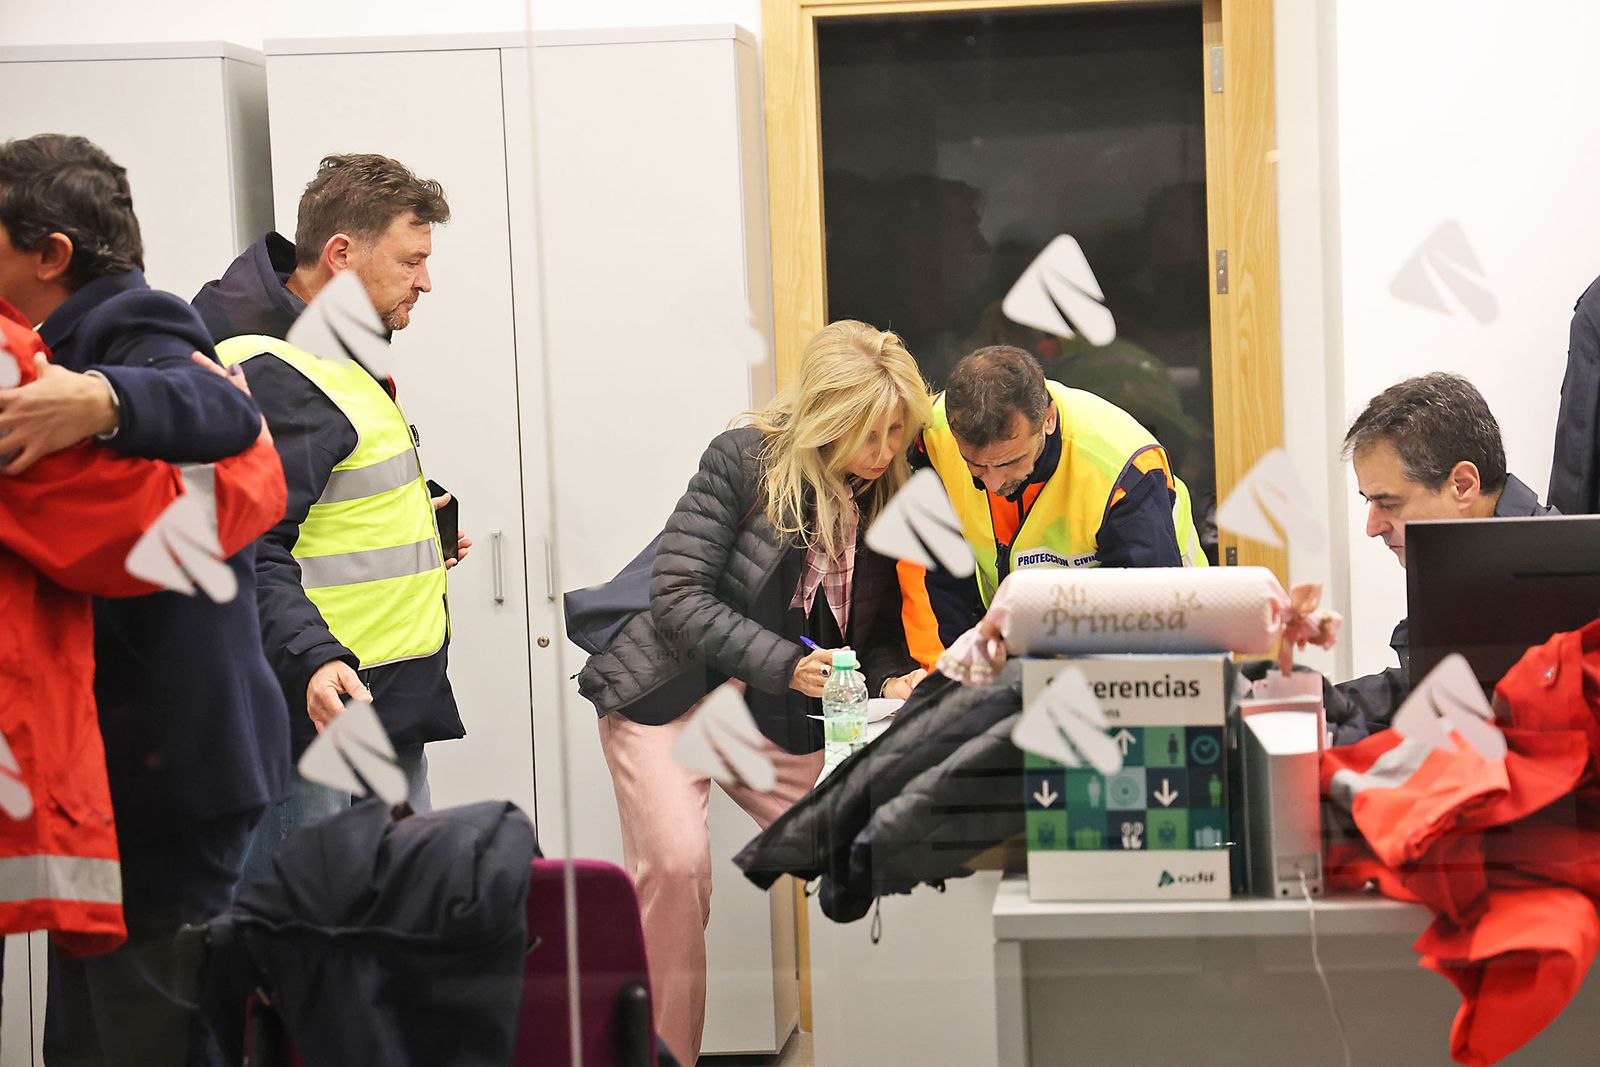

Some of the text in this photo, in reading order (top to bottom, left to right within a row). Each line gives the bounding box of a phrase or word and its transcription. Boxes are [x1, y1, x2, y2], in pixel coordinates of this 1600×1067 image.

[1017, 553, 1069, 567] PROTECCION
[1042, 606, 1188, 636] Princesa
[1046, 674, 1201, 699] erencias
